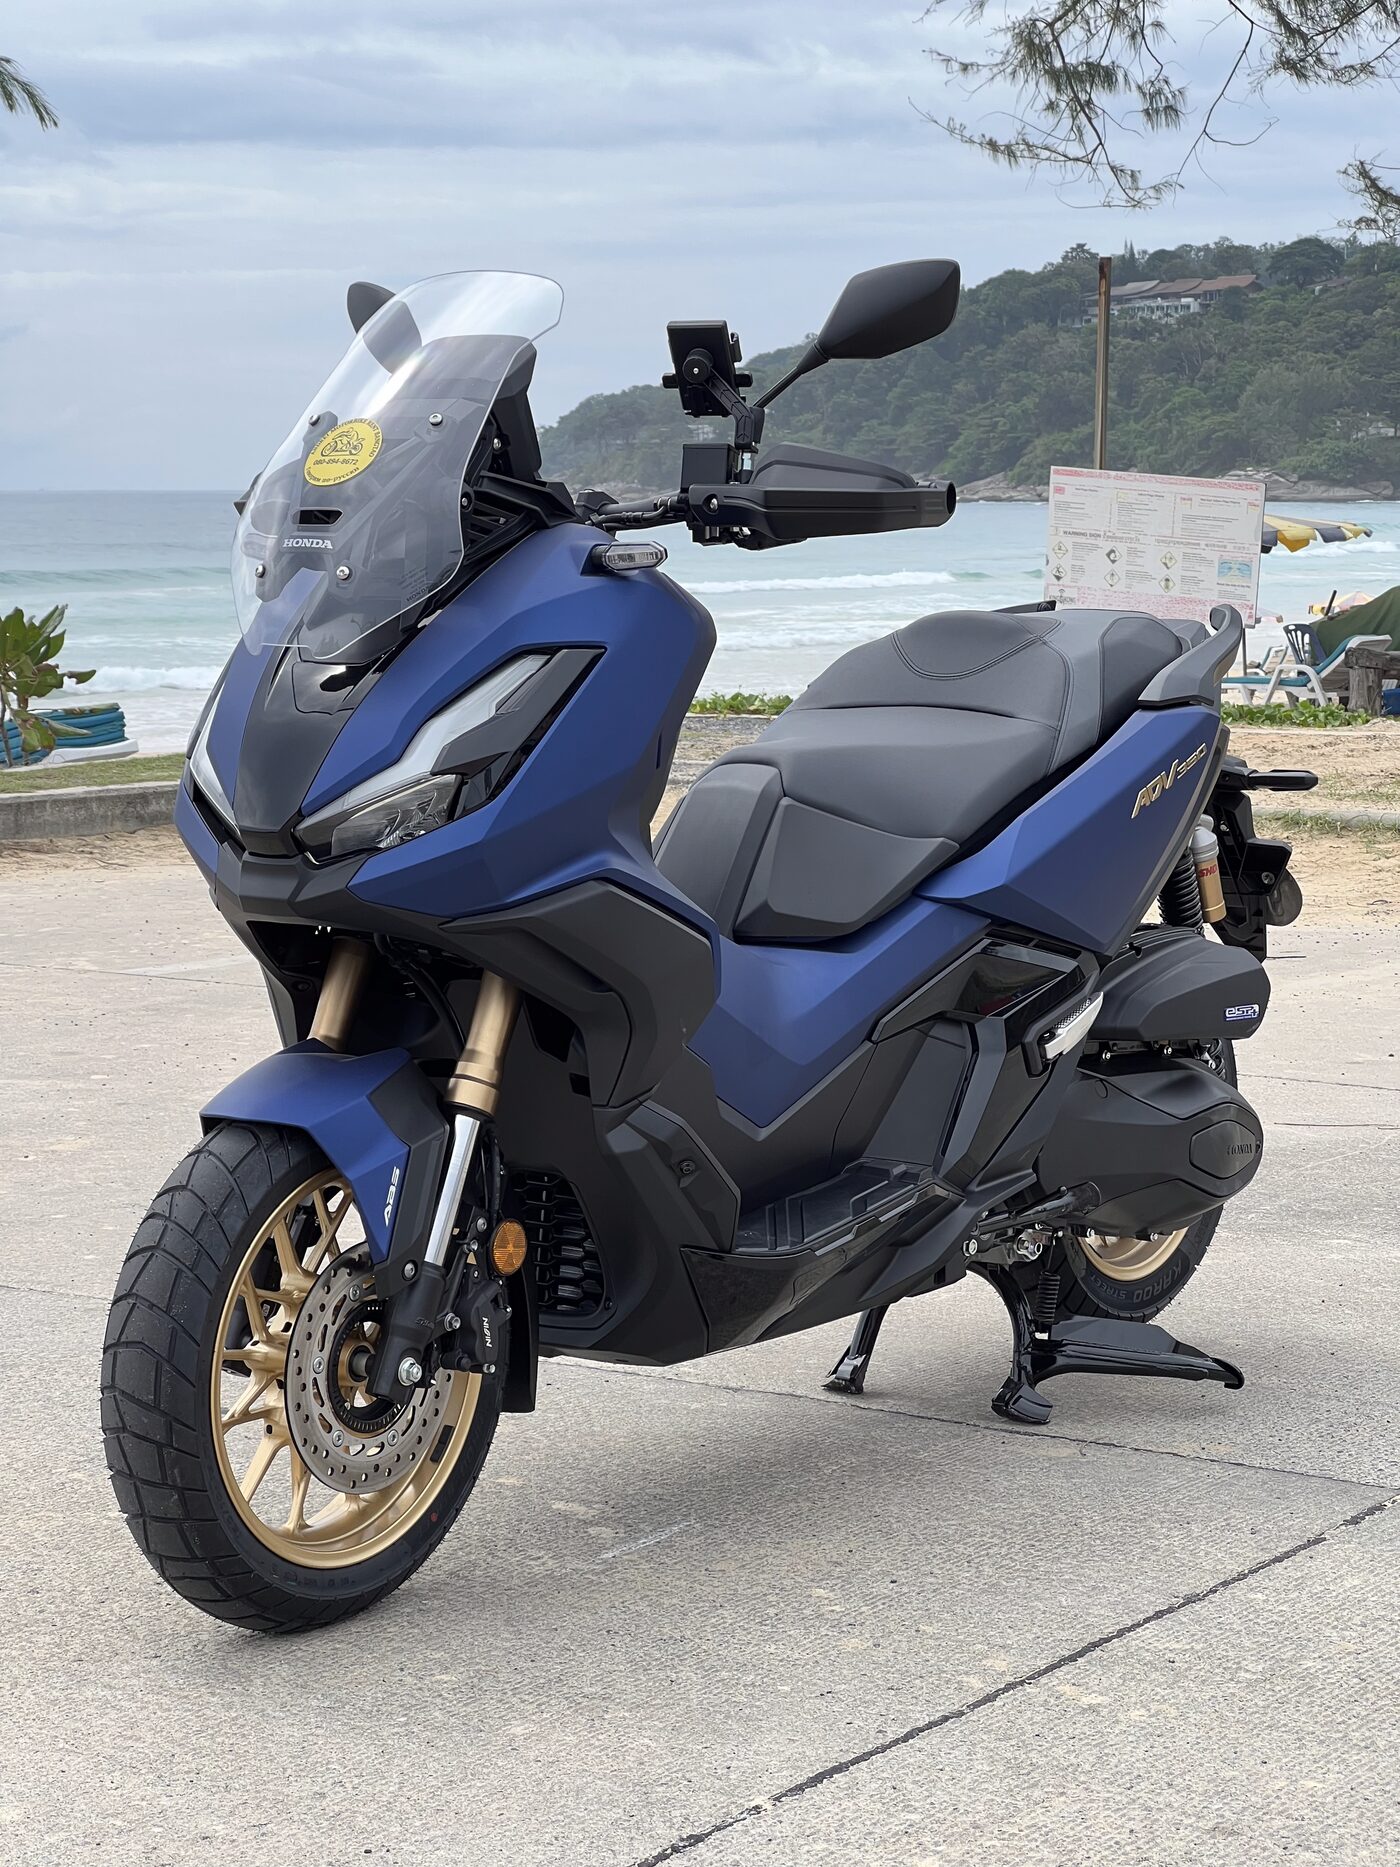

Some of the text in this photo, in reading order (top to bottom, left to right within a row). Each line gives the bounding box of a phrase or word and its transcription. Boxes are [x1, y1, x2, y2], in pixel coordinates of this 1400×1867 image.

[282, 538, 333, 549] HONDA
[1063, 529, 1087, 537] WARNING
[1131, 742, 1207, 819] ADV 350
[384, 1166, 400, 1227] ABS
[1089, 1259, 1182, 1303] KAROO STREET
